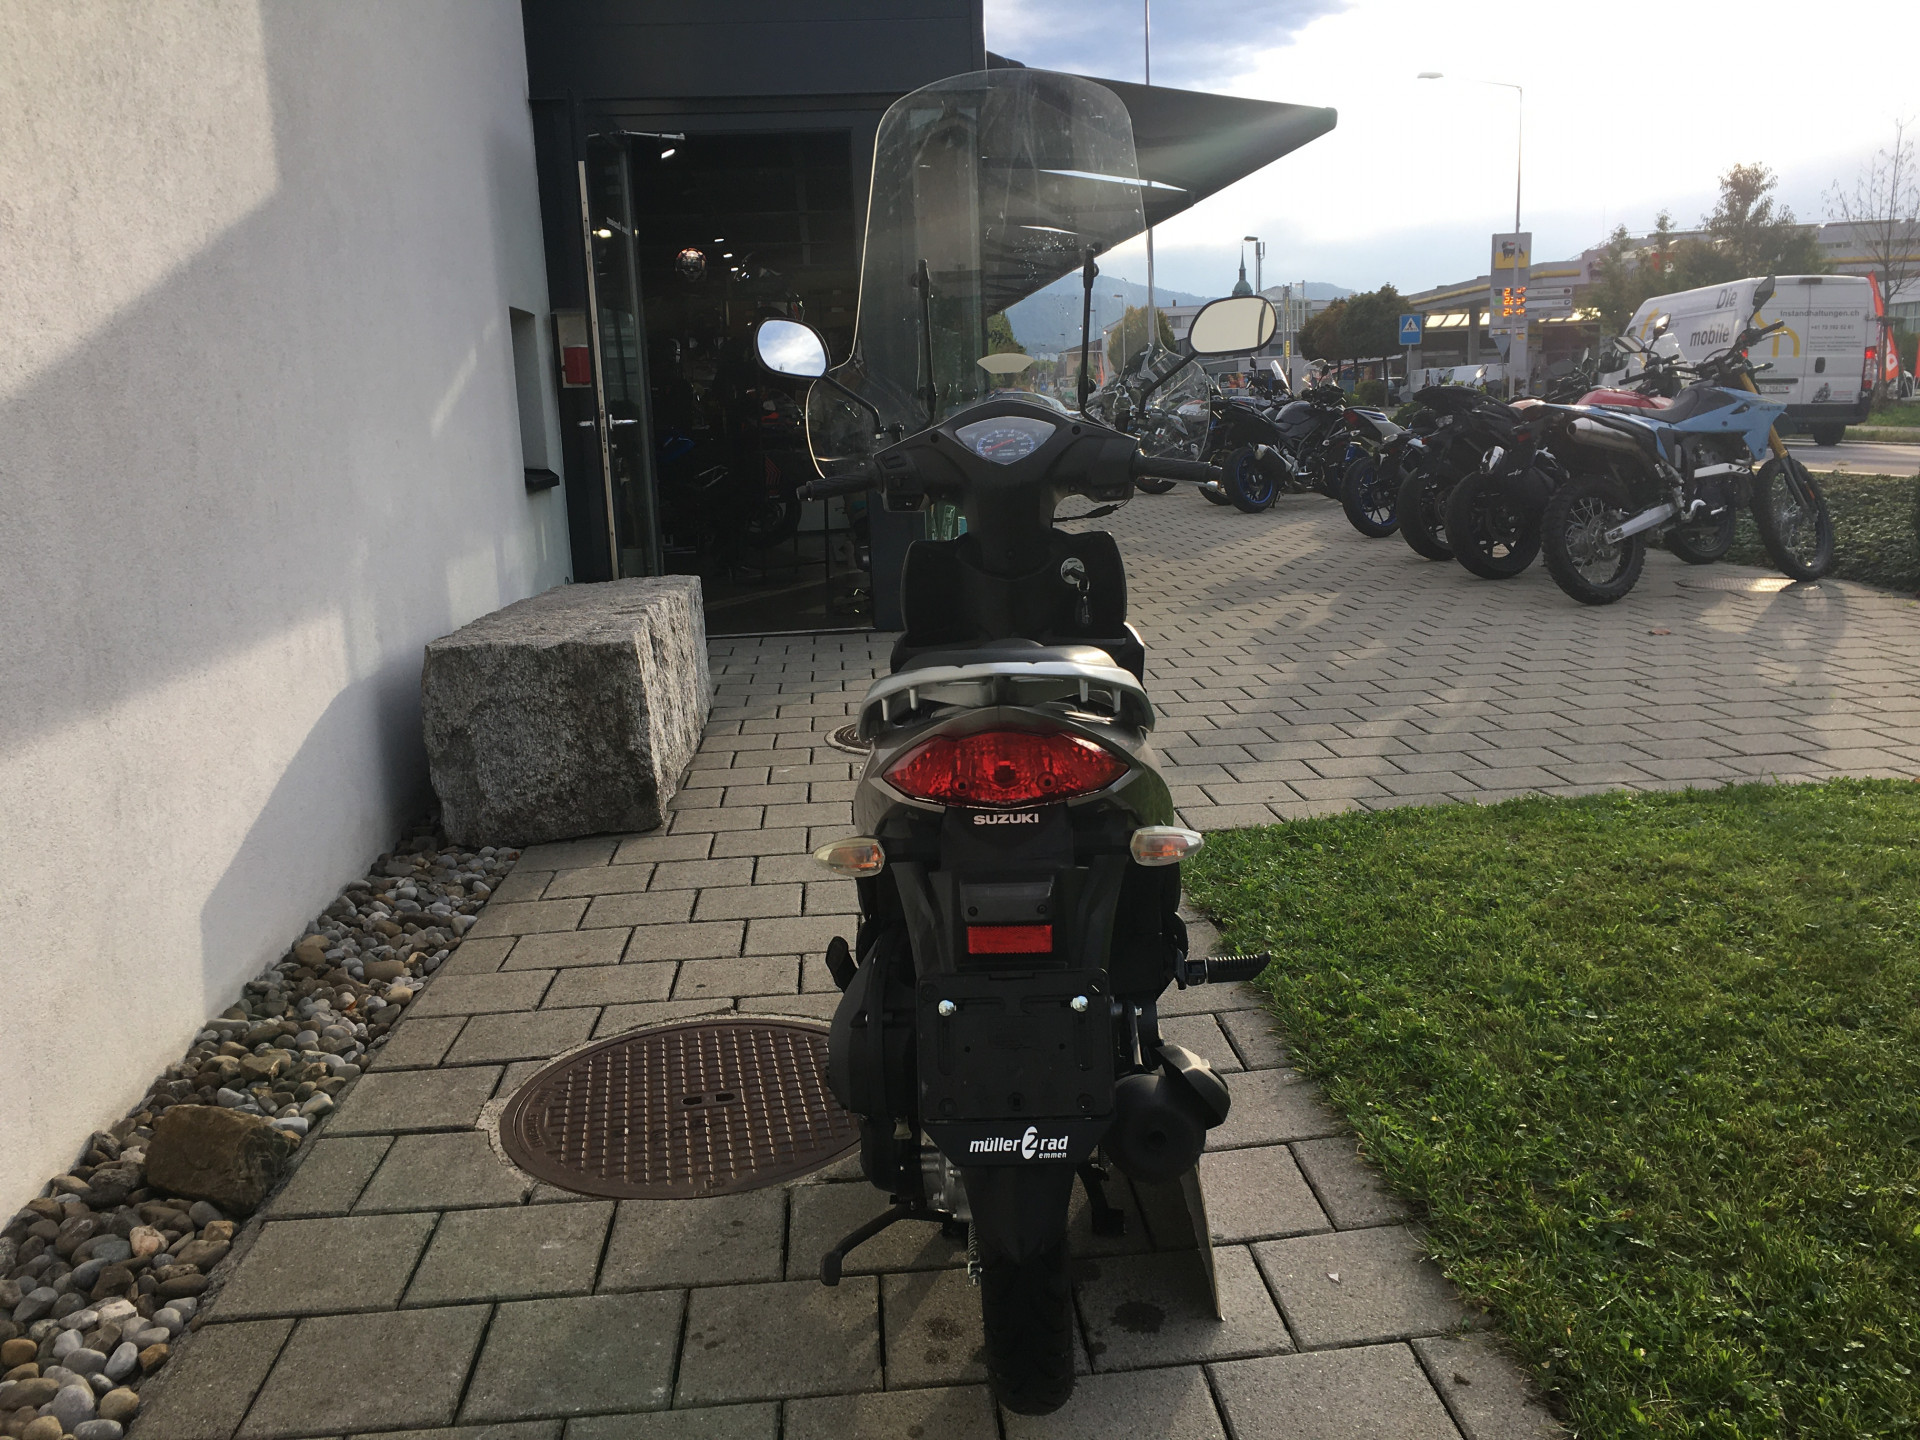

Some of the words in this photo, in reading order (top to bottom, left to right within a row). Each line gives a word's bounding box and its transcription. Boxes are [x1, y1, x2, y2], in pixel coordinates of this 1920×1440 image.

[1717, 288, 1738, 309] Die
[1780, 309, 1860, 318] Instandhaltungen.ch
[1690, 323, 1730, 347] mobile
[973, 813, 1040, 825] SUZUKI
